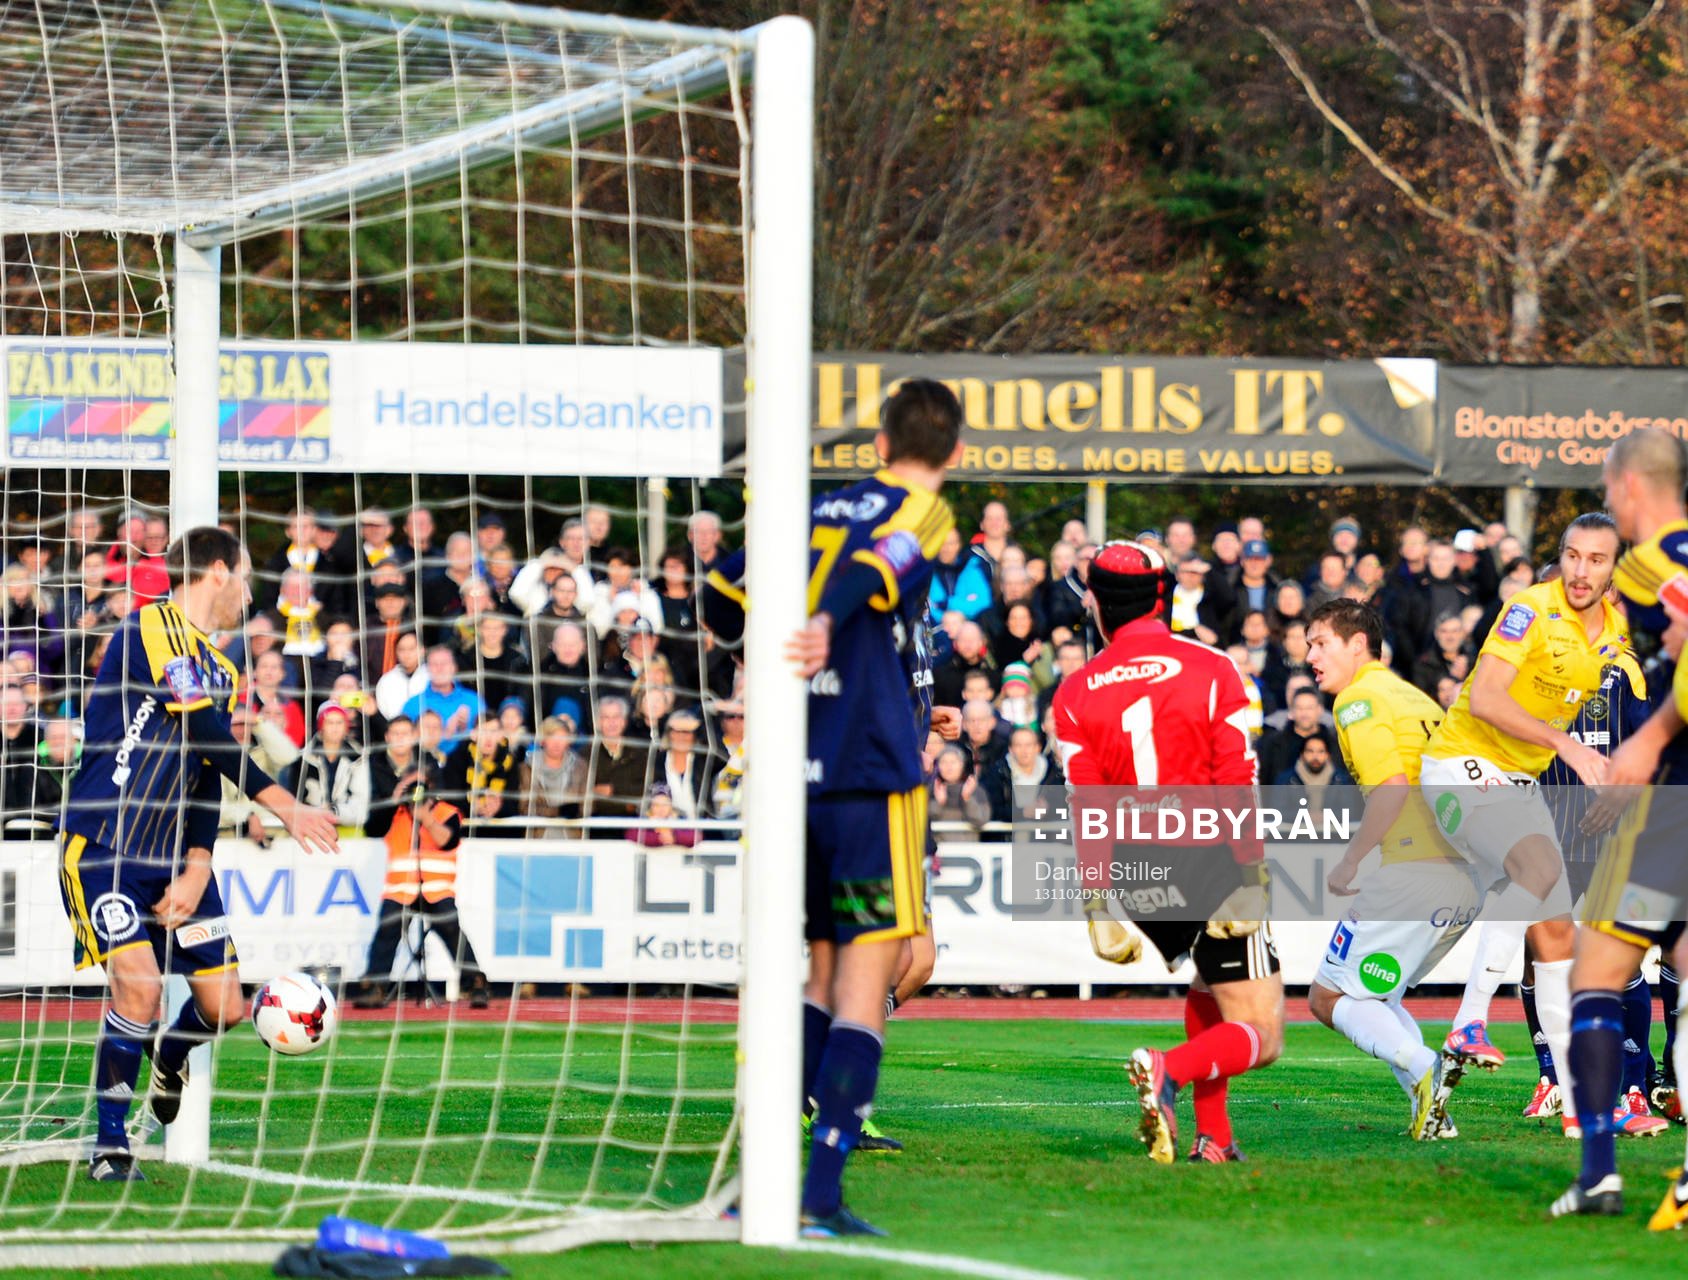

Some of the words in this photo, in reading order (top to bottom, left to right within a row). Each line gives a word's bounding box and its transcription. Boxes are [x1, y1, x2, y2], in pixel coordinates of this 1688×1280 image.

[8, 352, 256, 400] FALKENBGS
[261, 355, 330, 399] LAX
[375, 389, 713, 429] Handelsbanken
[815, 362, 1203, 434] Hnnells
[1228, 368, 1346, 437] IT.
[813, 444, 889, 469] LES
[1083, 448, 1186, 472] MORE
[1199, 450, 1345, 475] VALUES.
[1497, 440, 1542, 470] City
[1121, 696, 1159, 791] 1
[1464, 759, 1482, 780] 8
[634, 935, 743, 966] Katte
[1362, 962, 1397, 984] dina
